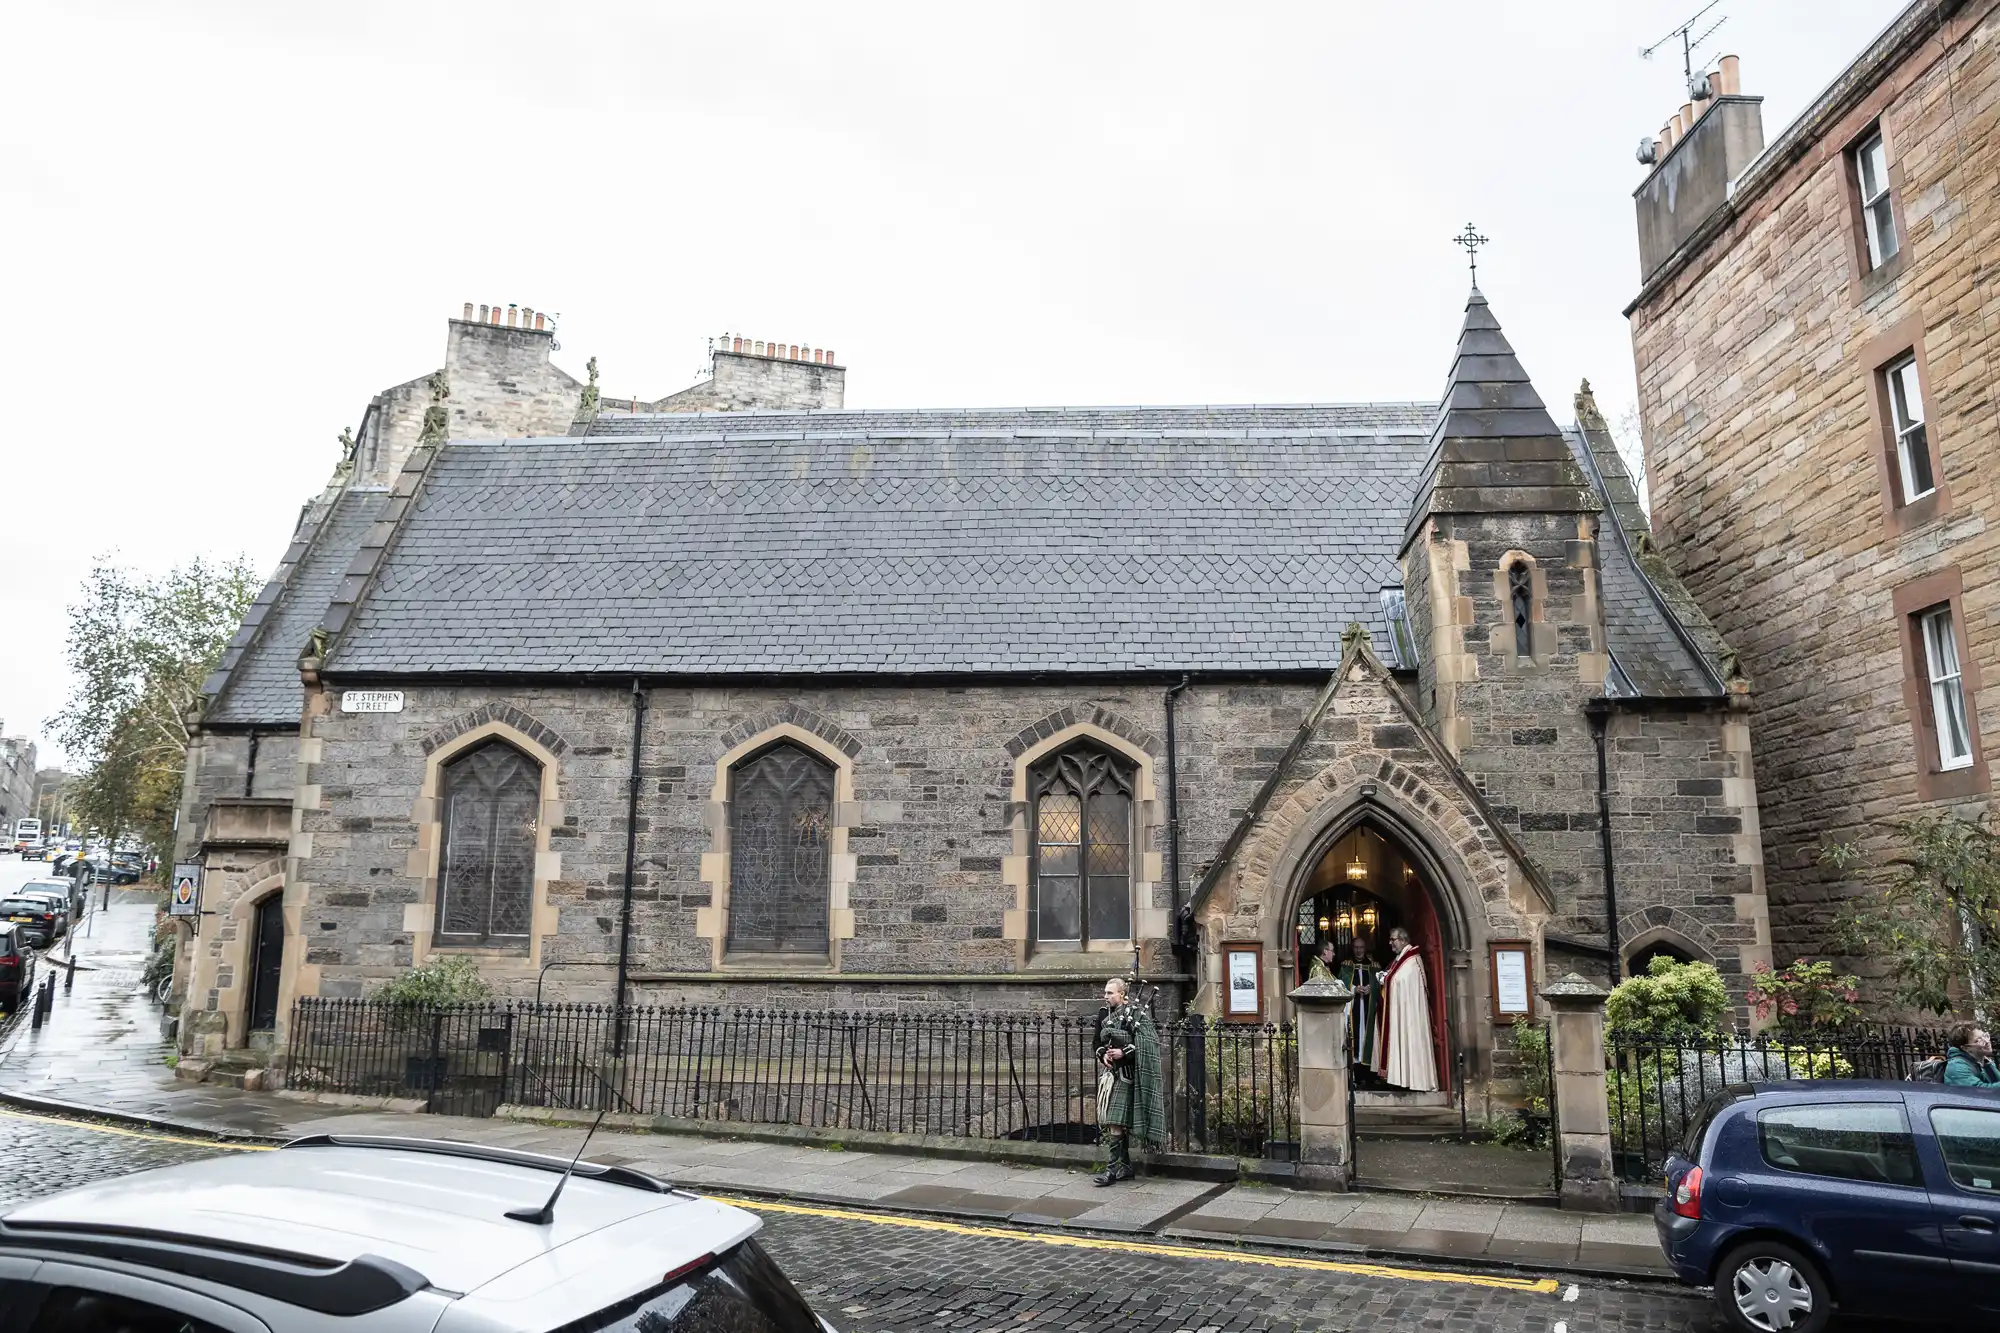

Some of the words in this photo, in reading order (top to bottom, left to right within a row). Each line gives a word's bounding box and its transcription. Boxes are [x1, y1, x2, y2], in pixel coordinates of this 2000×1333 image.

[347, 693, 358, 701] ST.
[361, 693, 400, 701] STEPHEN
[356, 702, 388, 710] STREET
